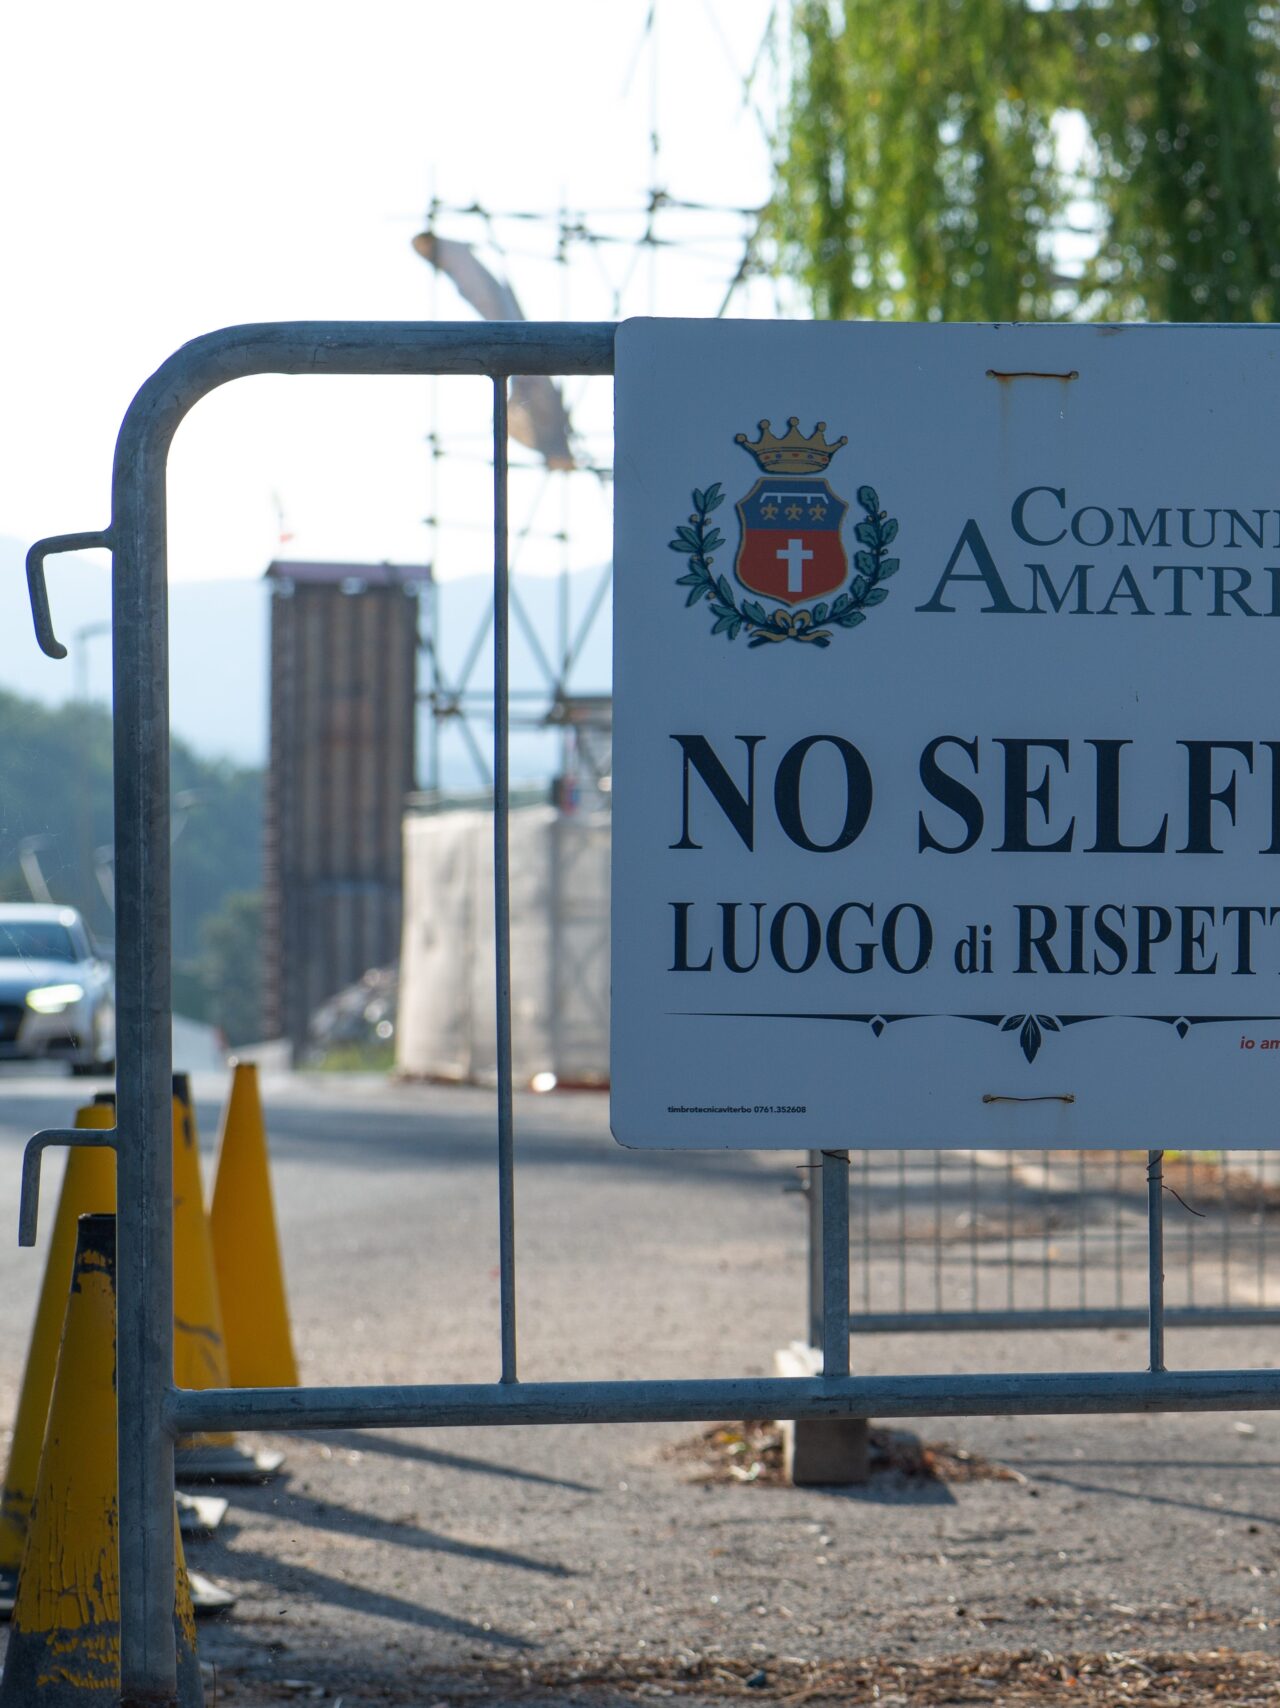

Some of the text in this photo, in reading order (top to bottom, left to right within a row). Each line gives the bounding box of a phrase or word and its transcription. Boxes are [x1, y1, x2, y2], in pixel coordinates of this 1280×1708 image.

[668, 733, 874, 854] NO
[667, 901, 934, 975] LUOGO
[953, 926, 994, 975] di
[1239, 1035, 1256, 1051] io
[667, 1105, 807, 1114] timbrotecnicaviterbo 0761.352608
